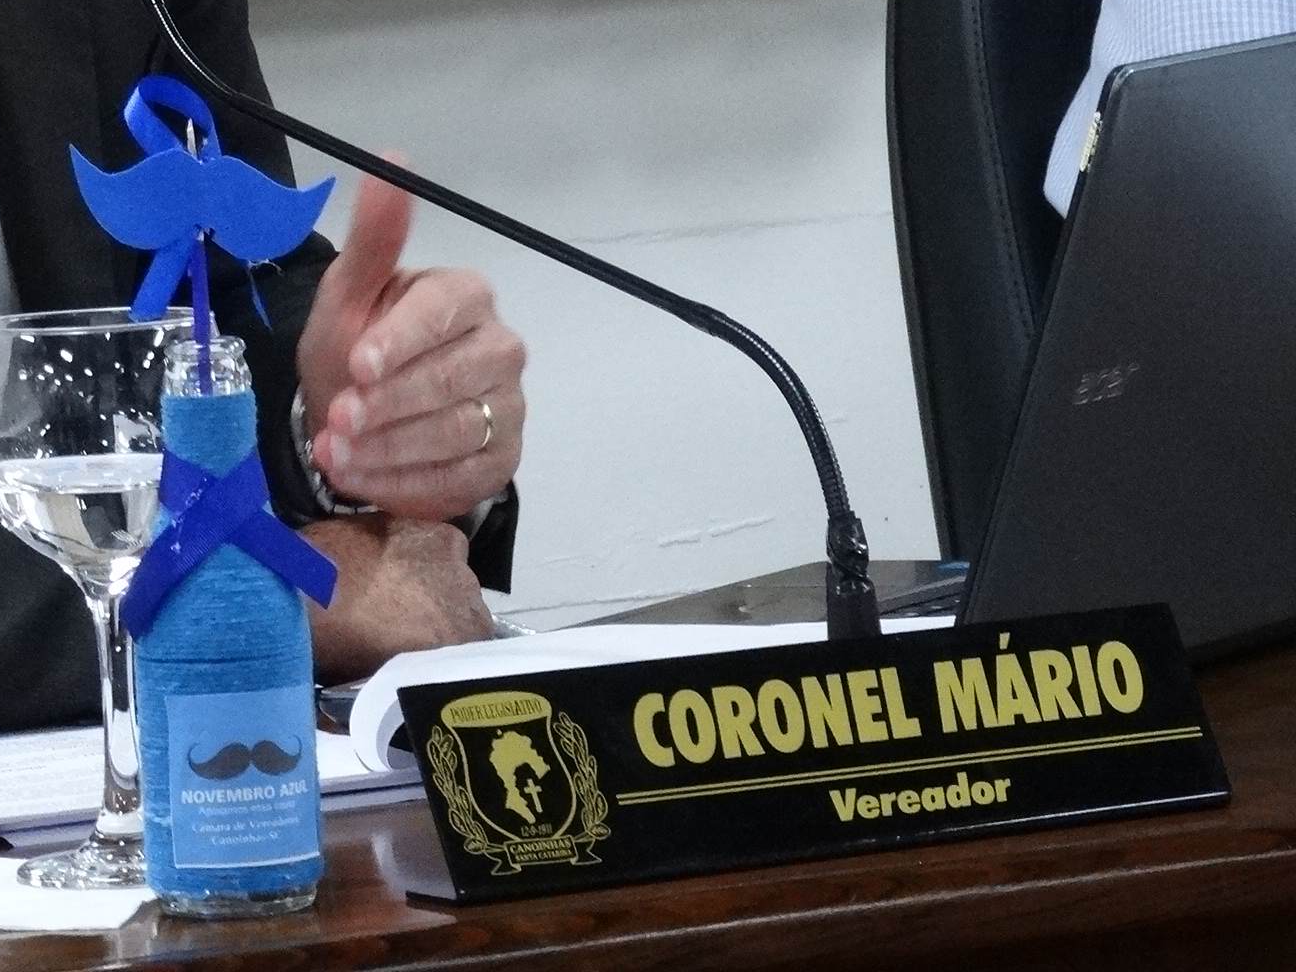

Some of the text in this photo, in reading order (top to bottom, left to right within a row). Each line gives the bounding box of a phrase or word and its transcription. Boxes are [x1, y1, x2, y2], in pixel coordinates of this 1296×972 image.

[449, 697, 543, 723] PODER LEGISLATIVO
[633, 631, 1144, 768] CORONEL MÁRIO
[181, 780, 308, 804] NOVEMBRO AZUL
[829, 771, 1011, 823] Vereador
[509, 838, 573, 856] CANOINHAS
